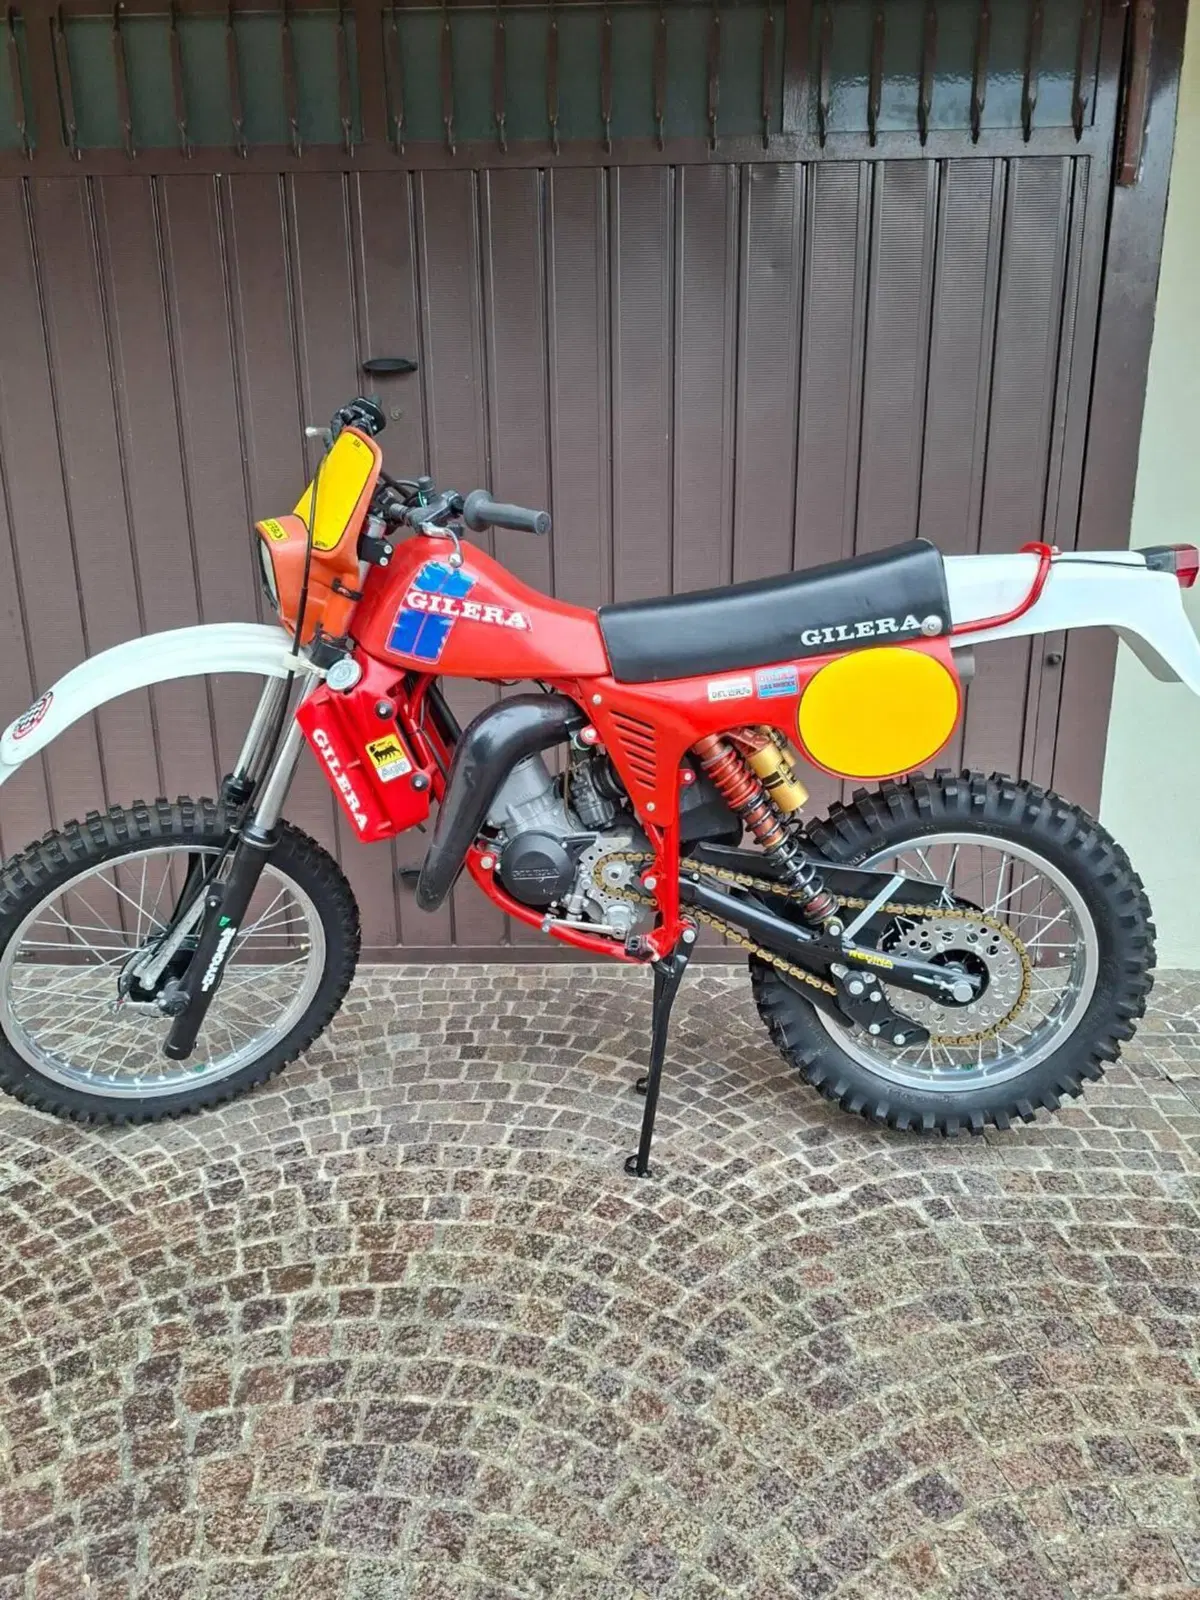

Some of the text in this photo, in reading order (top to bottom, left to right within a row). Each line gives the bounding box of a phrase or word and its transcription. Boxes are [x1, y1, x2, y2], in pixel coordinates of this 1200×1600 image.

[407, 592, 527, 628] GILERA
[801, 614, 921, 646] GILERA
[312, 728, 368, 831] GILERA
